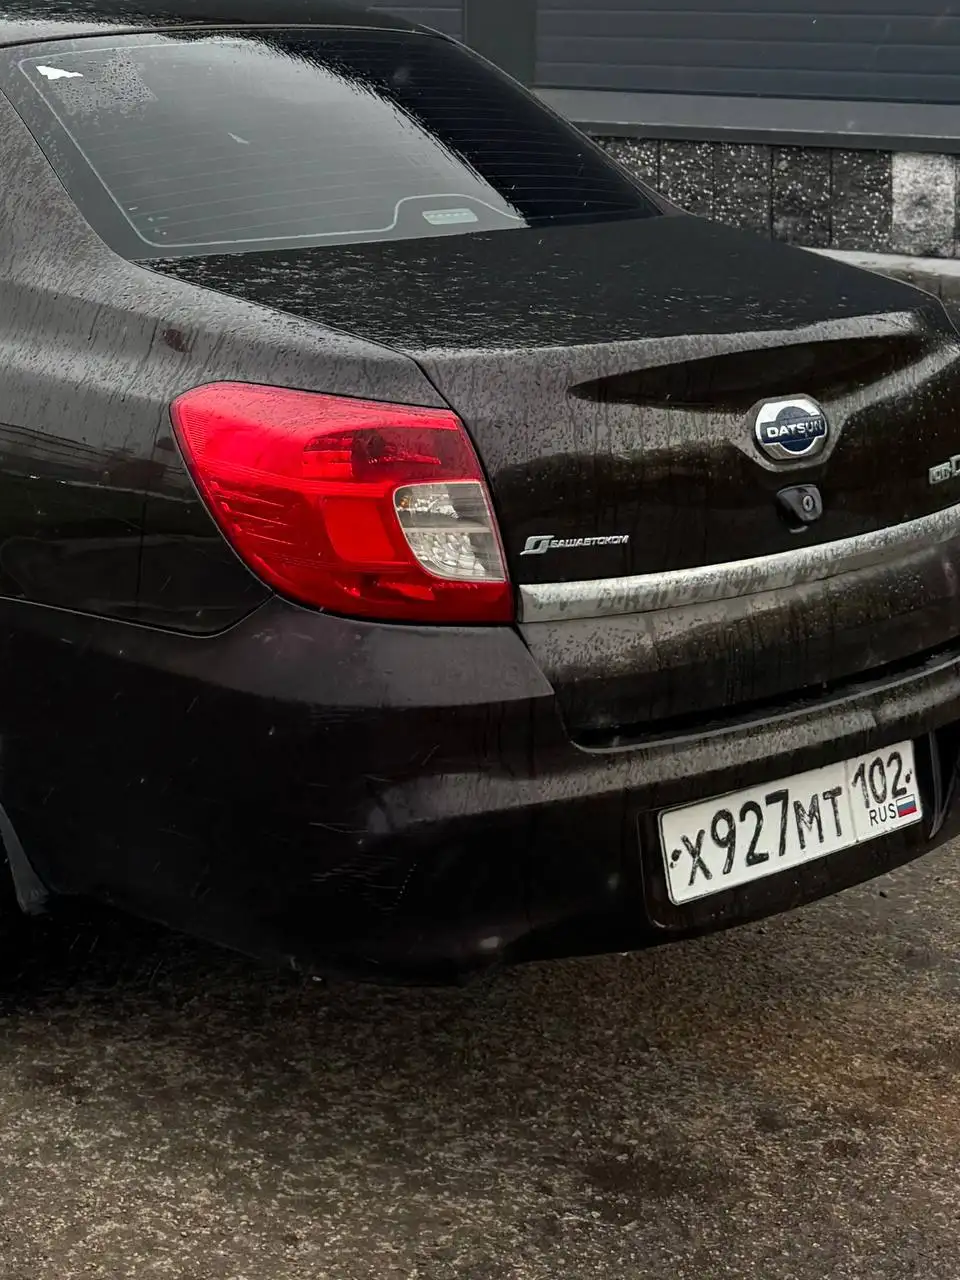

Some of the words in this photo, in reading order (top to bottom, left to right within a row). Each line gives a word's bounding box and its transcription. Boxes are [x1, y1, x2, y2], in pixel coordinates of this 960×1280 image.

[766, 419, 823, 438] DATSUN
[548, 535, 630, 549] БАШАВТОКОМ
[852, 751, 908, 809] 102
[869, 805, 897, 826] RUS
